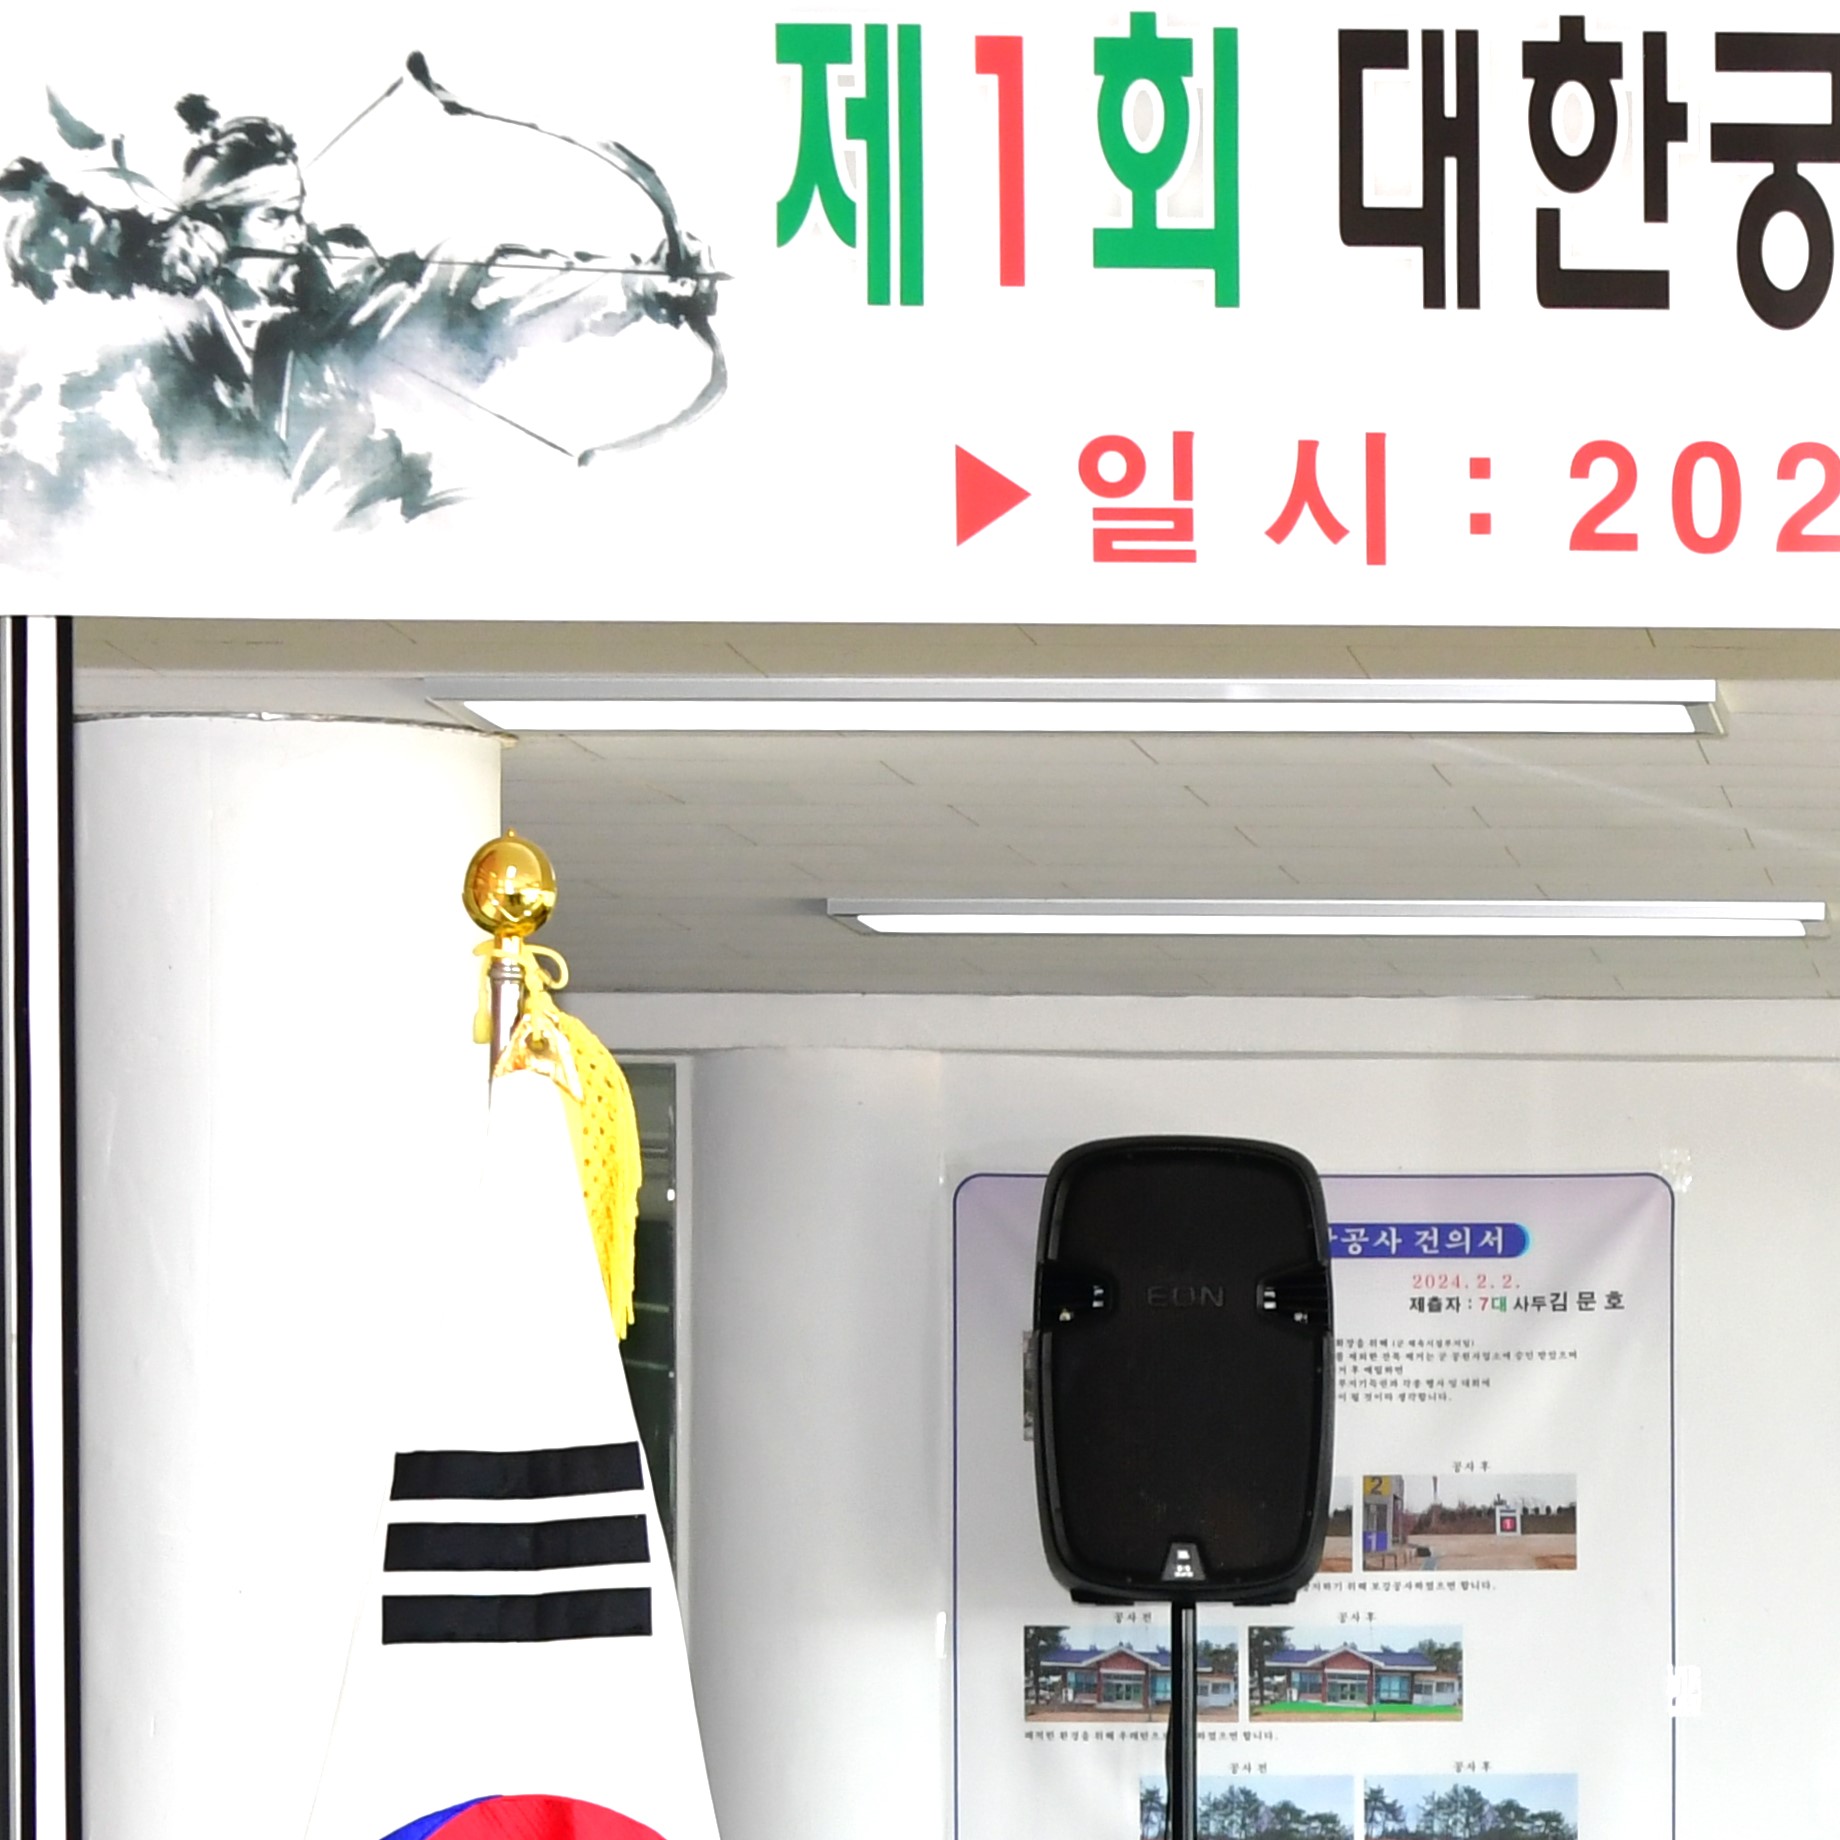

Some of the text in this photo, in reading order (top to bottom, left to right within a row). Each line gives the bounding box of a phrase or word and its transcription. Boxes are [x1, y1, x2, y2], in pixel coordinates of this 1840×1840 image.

[776, 12, 1239, 307] 제1회
[1414, 1226, 1504, 1255] 건의서
[1479, 1296, 1507, 1312] 7대
